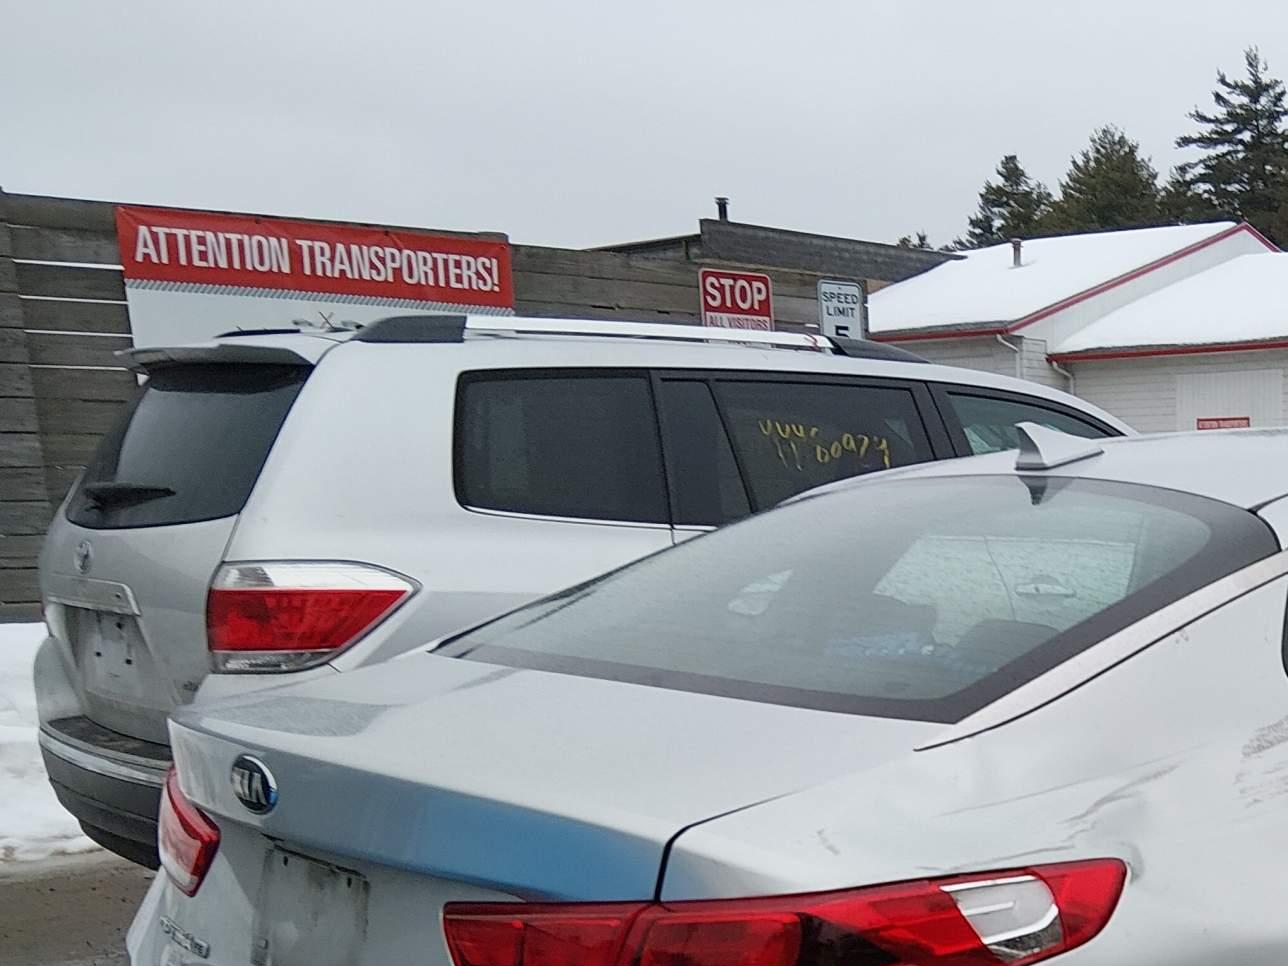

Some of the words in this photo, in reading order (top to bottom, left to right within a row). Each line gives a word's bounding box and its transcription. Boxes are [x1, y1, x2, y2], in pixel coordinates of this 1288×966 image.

[135, 225, 291, 274] ATTENTION
[296, 239, 501, 292] TRANSPORTERS!
[705, 276, 767, 310] STOP
[822, 291, 859, 305] SPEED
[826, 305, 856, 318] LIMIT
[709, 315, 724, 327] ALL
[728, 318, 769, 331] VISITORS
